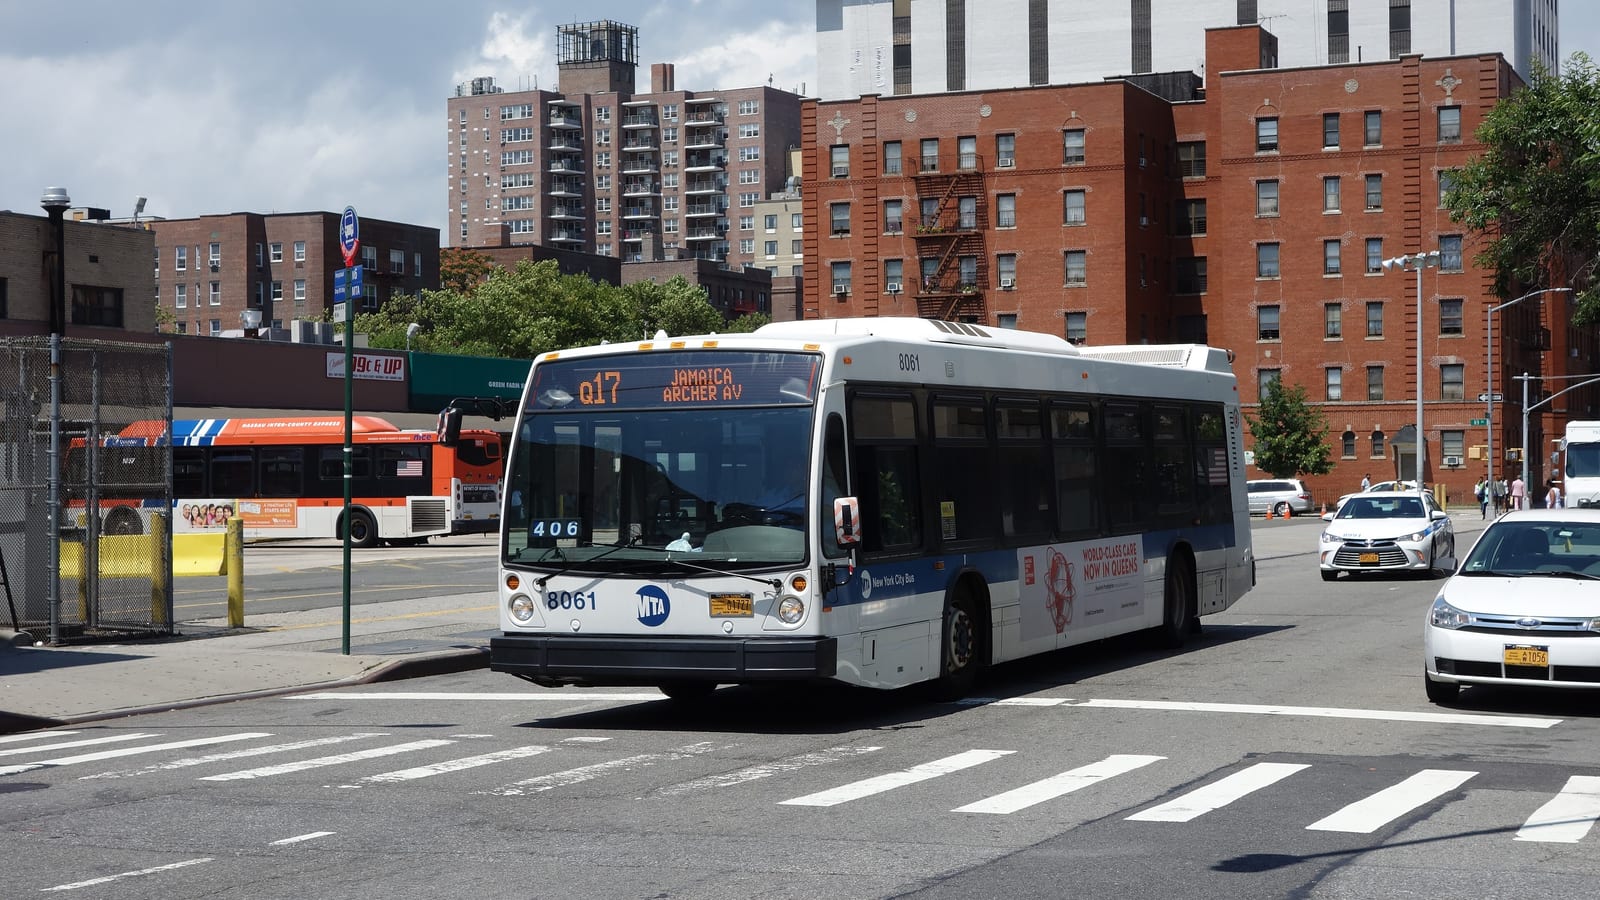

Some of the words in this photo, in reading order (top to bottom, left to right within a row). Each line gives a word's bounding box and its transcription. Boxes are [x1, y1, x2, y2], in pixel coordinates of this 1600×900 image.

[384, 358, 402, 374] UP
[898, 352, 920, 371] 8061
[671, 368, 732, 386] JAMAICA
[579, 371, 621, 405] Q17
[663, 386, 718, 402] ARCHER
[722, 384, 743, 400] AV
[1083, 546, 1122, 561] WORLD-CLASS
[1122, 543, 1136, 558] CARE
[1084, 562, 1100, 581] NOW
[1102, 561, 1110, 577] IN
[1112, 558, 1138, 576] QUEENS
[872, 577, 884, 588] New
[884, 576, 894, 586] York
[895, 574, 904, 586] City
[905, 572, 914, 584] Bus
[548, 592, 596, 610] 8061
[636, 594, 664, 618] MTA
[1528, 652, 1546, 663] 1056
